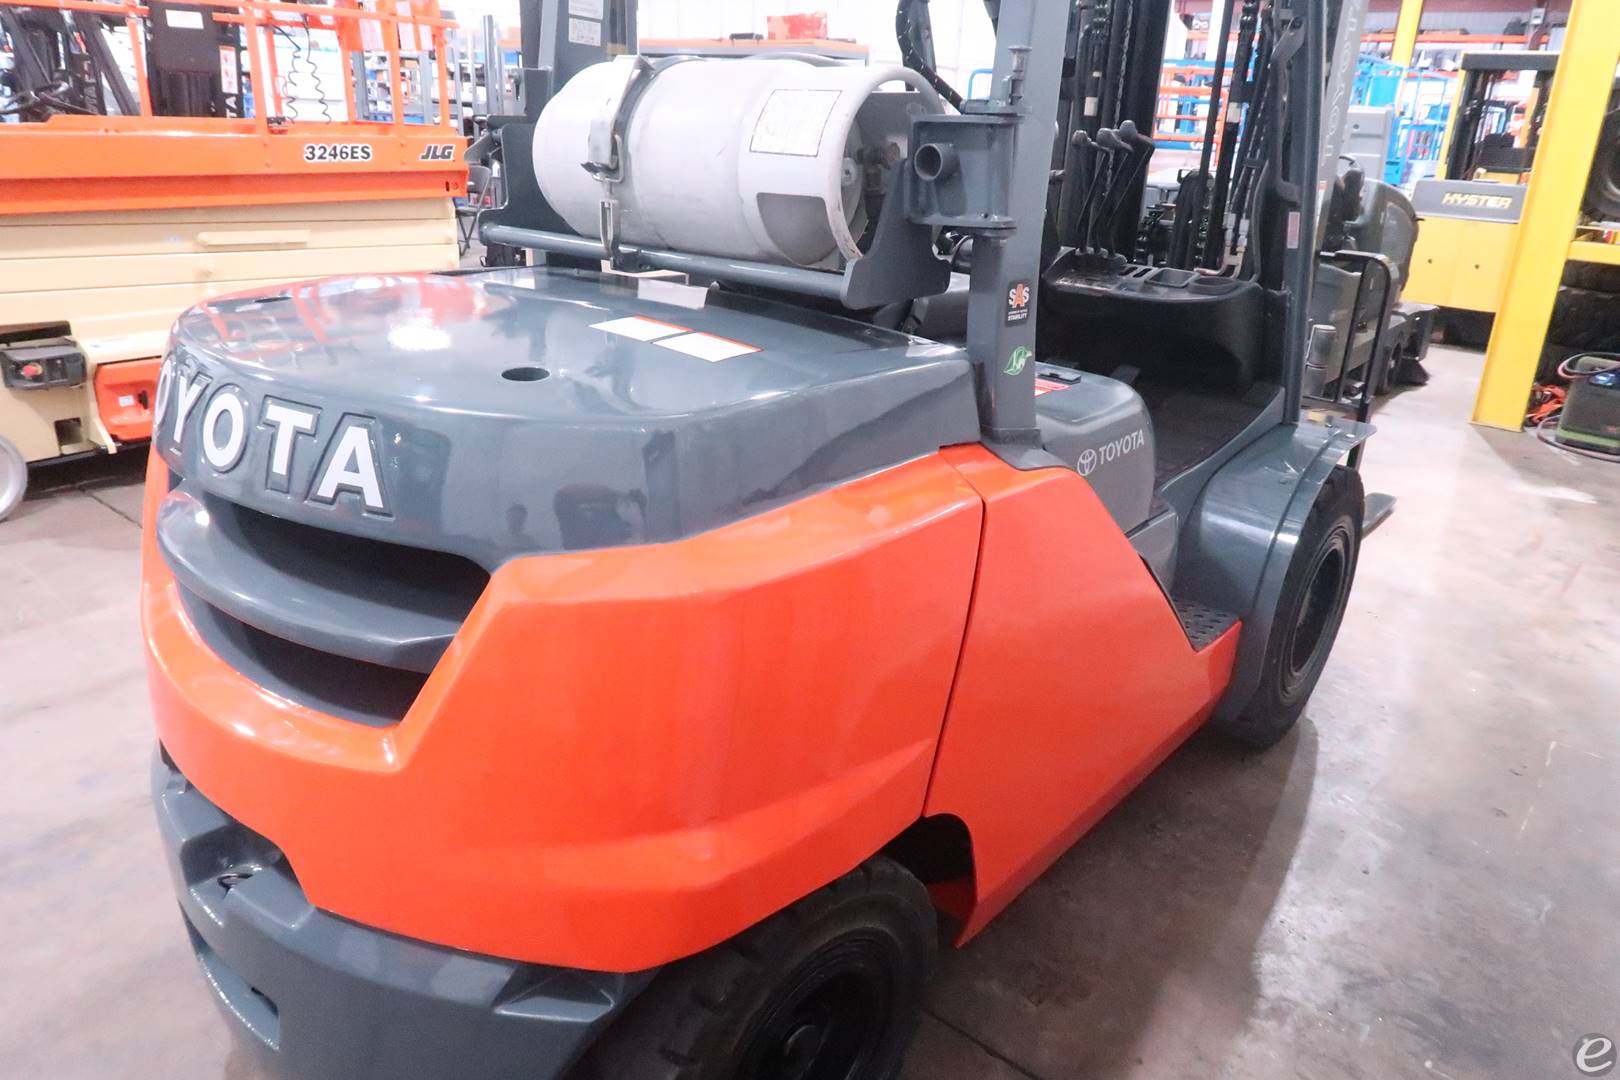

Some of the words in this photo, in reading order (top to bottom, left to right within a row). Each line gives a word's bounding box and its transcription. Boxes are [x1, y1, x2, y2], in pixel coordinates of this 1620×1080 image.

[304, 144, 372, 161] 3246ES
[420, 145, 455, 161] JLG
[1441, 192, 1513, 209] HYSTER
[1008, 284, 1030, 309] SAS
[1099, 429, 1145, 465] TOYOTA
